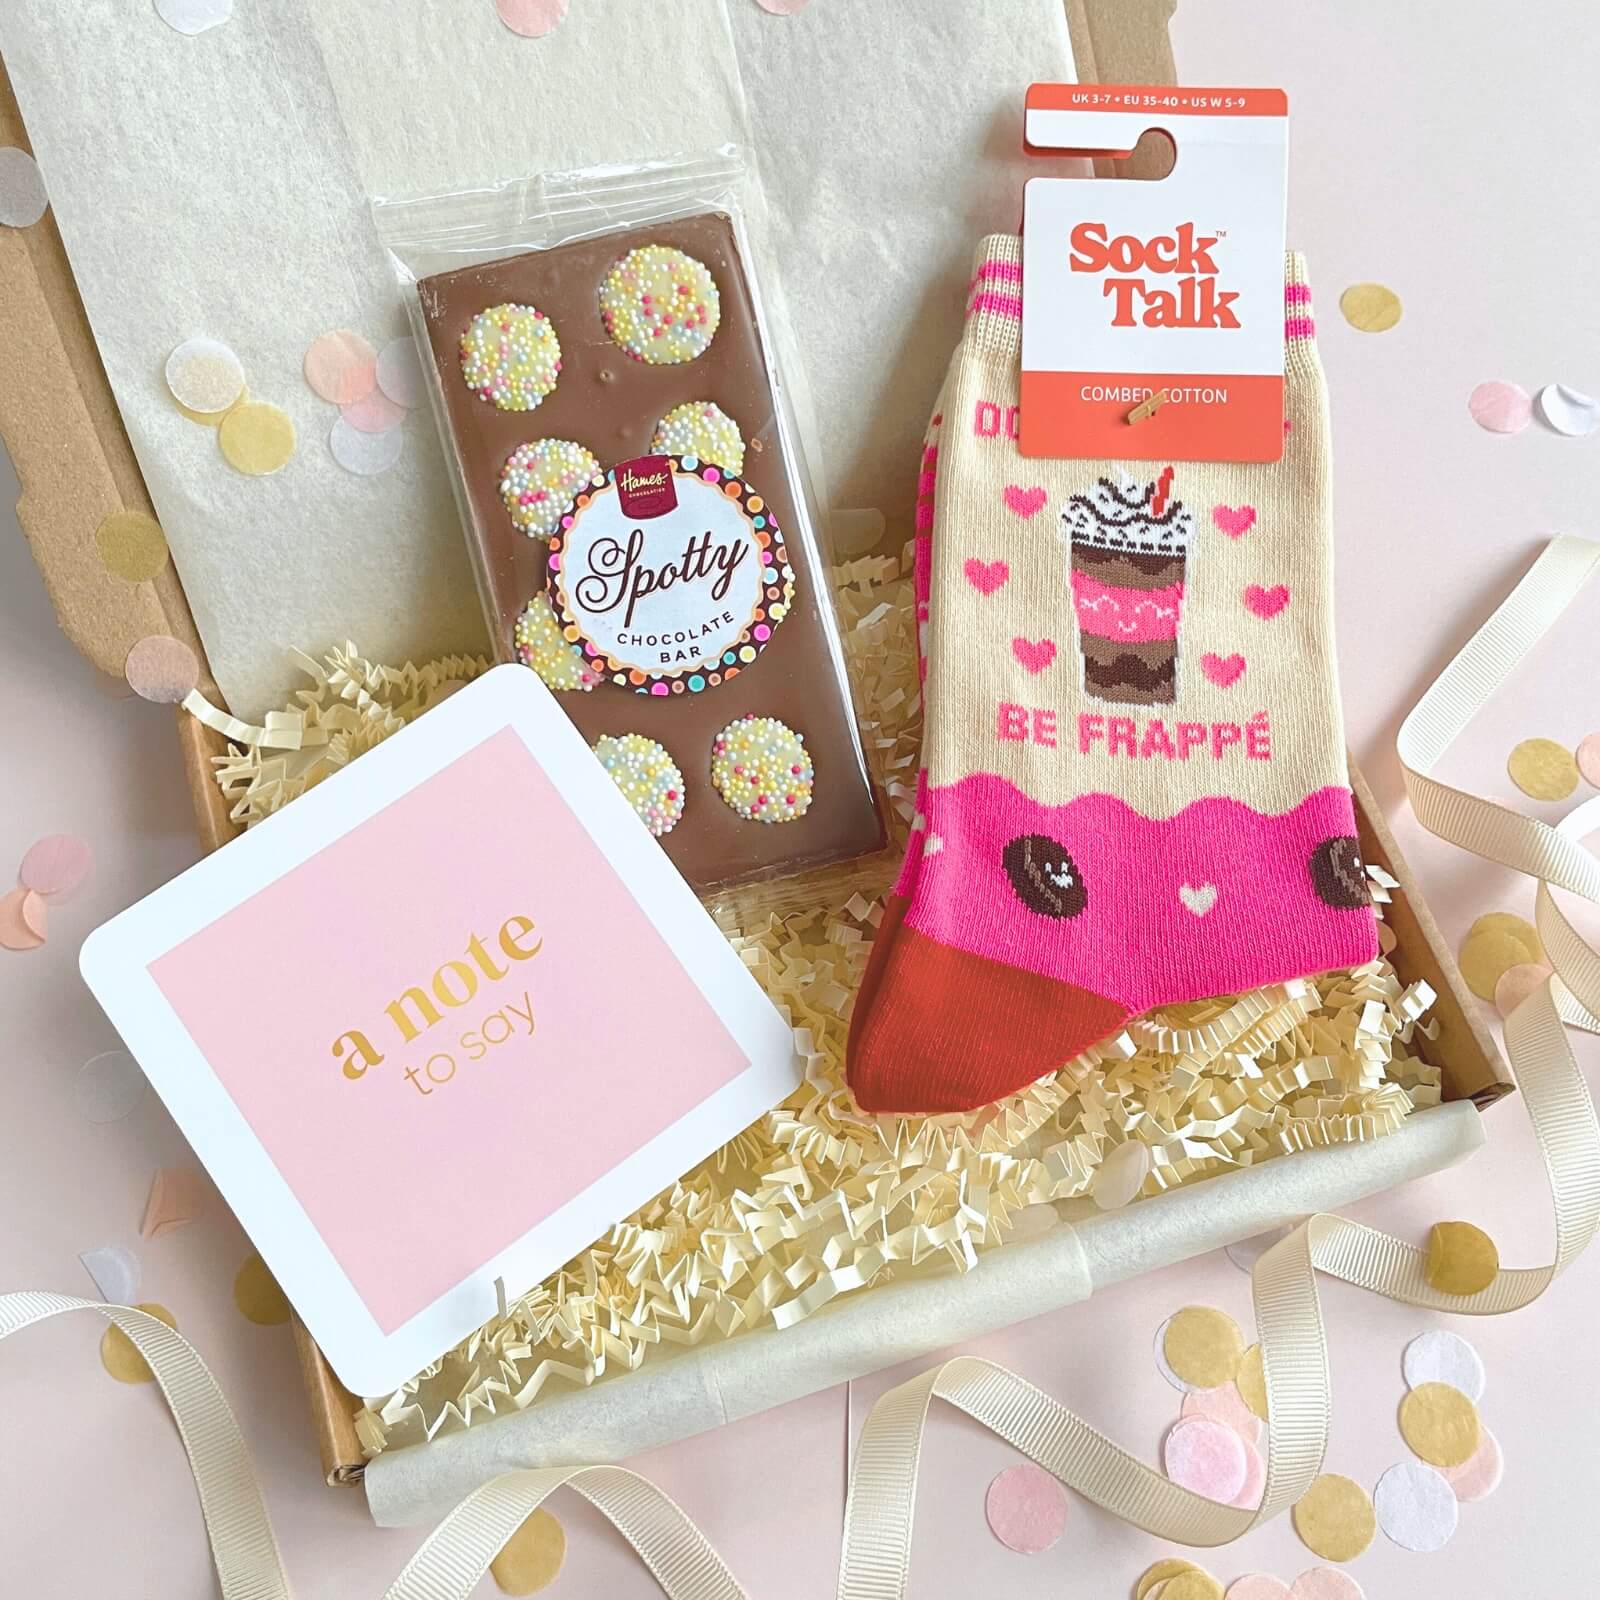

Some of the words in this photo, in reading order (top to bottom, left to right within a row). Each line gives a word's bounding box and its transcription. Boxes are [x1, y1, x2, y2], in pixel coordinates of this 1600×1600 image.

[1072, 93, 1089, 103] UK
[1092, 94, 1111, 104] 3-7
[1123, 95, 1140, 105] EU
[1143, 96, 1178, 107] 35-40
[1191, 97, 1207, 107] US
[1210, 98, 1222, 107] W
[1225, 98, 1246, 108] 5-9
[1069, 222, 1219, 275] Sock
[1103, 276, 1242, 329] Talk
[575, 529, 749, 628] Spotty
[617, 611, 735, 646] CHOCOLATE
[660, 646, 703, 663] BAR
[997, 701, 1057, 749] BE
[1077, 709, 1272, 761] FRAPPÉ
[332, 1030, 385, 1080] a
[384, 915, 543, 1044] note
[404, 1053, 456, 1095] to
[460, 991, 535, 1061] say
